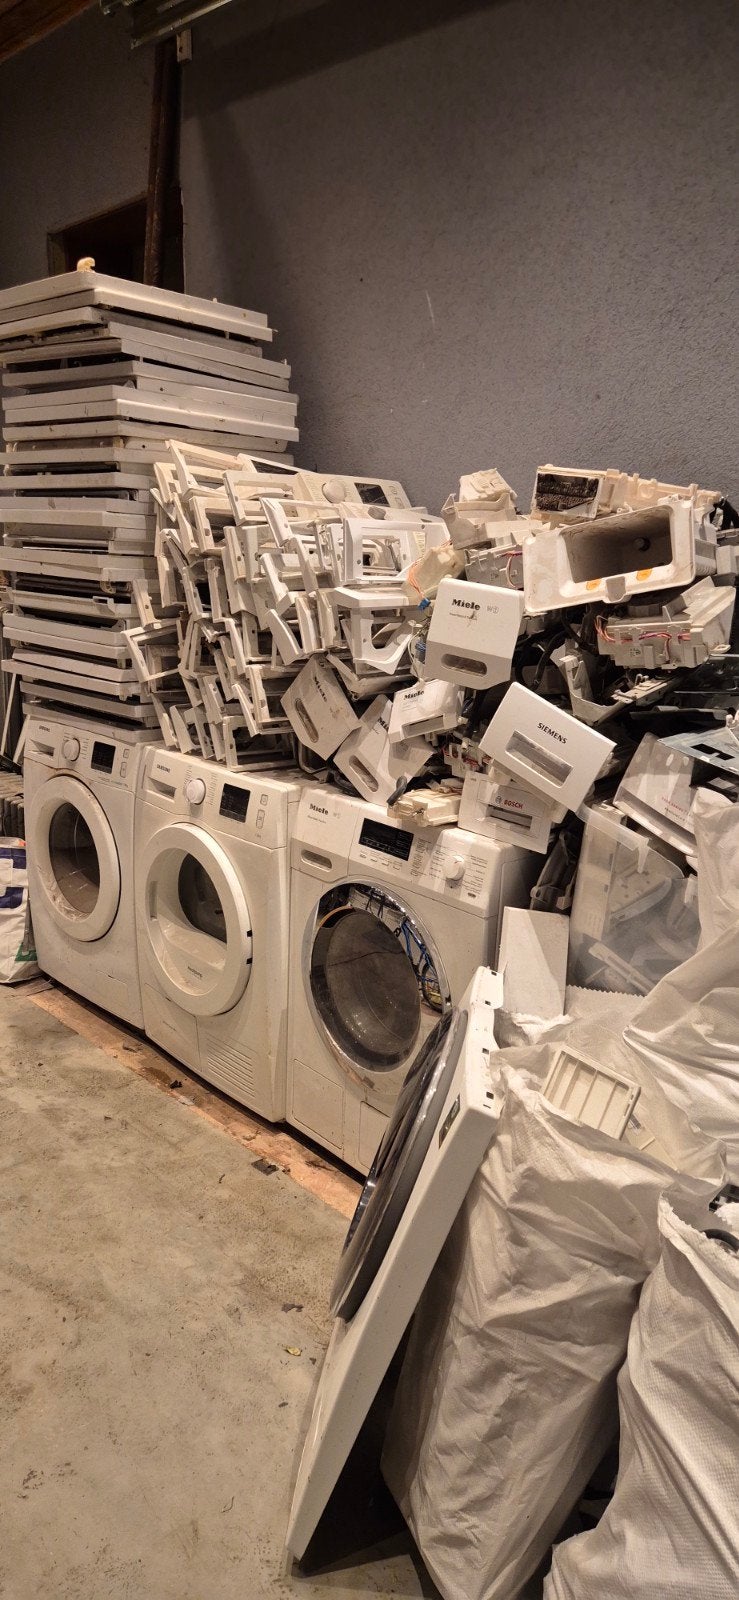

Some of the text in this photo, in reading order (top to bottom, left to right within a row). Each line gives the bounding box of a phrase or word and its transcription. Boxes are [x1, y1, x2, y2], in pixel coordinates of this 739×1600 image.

[452, 599, 480, 611] Miele
[314, 676, 327, 702] Miele
[403, 690, 425, 701] Miele
[537, 722, 568, 744] SIEMENS
[309, 803, 329, 816] Miele
[503, 799, 524, 809] BOSCH
